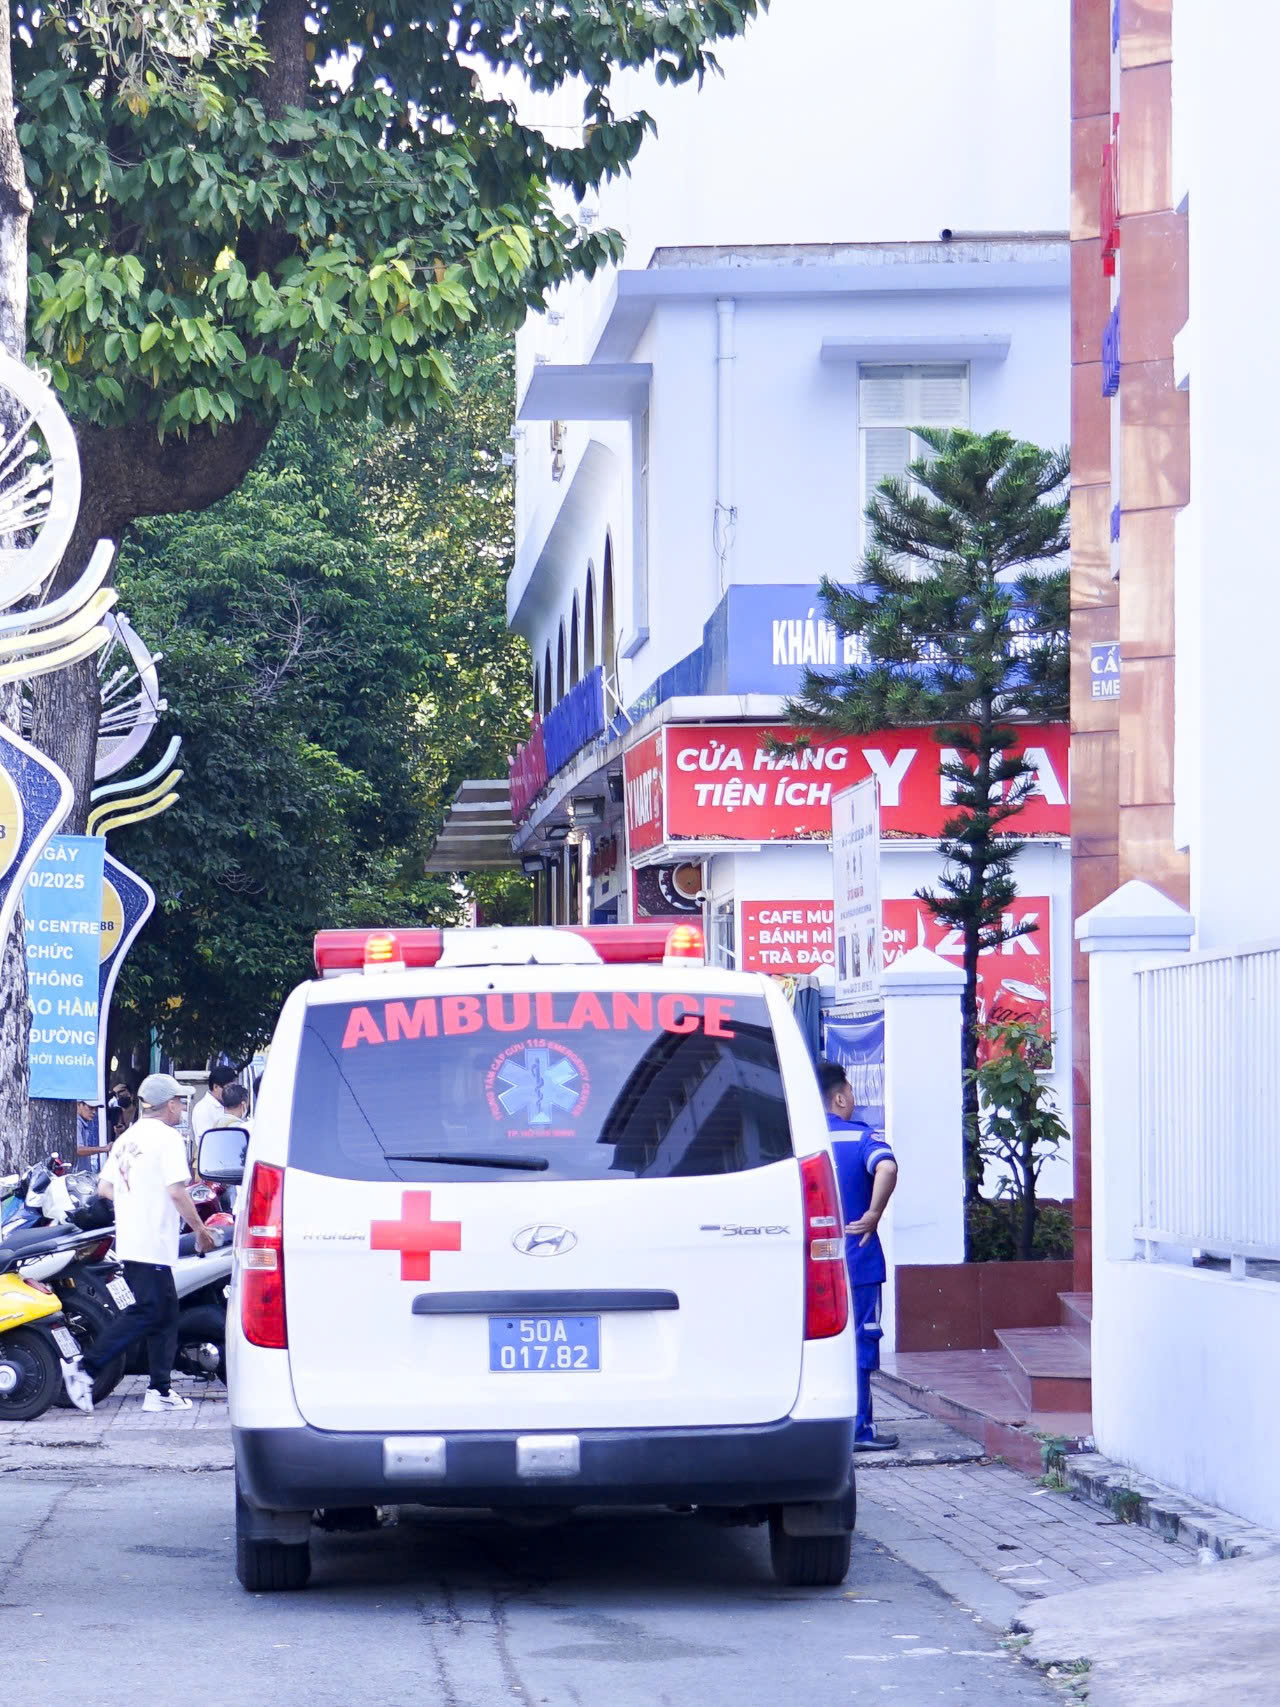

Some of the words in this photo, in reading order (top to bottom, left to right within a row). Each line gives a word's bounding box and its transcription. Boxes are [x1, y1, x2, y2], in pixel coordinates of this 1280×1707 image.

[772, 608, 837, 665] KHÁM
[1091, 646, 1122, 674] CẤ
[676, 740, 744, 772] CỬA
[753, 743, 848, 771] HÀNG
[862, 748, 918, 807] Y
[940, 747, 1071, 805] MA
[694, 778, 770, 812] TIỆN
[774, 775, 832, 806] ÍCH
[38, 844, 79, 862] GÀY
[28, 871, 86, 889] 0/2025
[39, 919, 100, 935] CENTRE
[758, 910, 803, 925] CAFE
[759, 926, 808, 944] BÁNH
[812, 926, 832, 944] MÌ
[26, 942, 74, 959] CHỨC
[760, 946, 794, 964] TRÀ
[796, 946, 835, 964] ĐÀO
[27, 969, 84, 988] THÔNG
[57, 996, 98, 1017] HÀM
[341, 992, 736, 1049] AMBULANCE
[29, 1026, 96, 1046] ĐƯỜNG
[526, 1039, 545, 1047] 115
[55, 1054, 95, 1067] NGHĨA
[722, 1224, 790, 1236] Starex
[520, 1319, 568, 1342] 50A
[500, 1345, 589, 1369] 017.82
